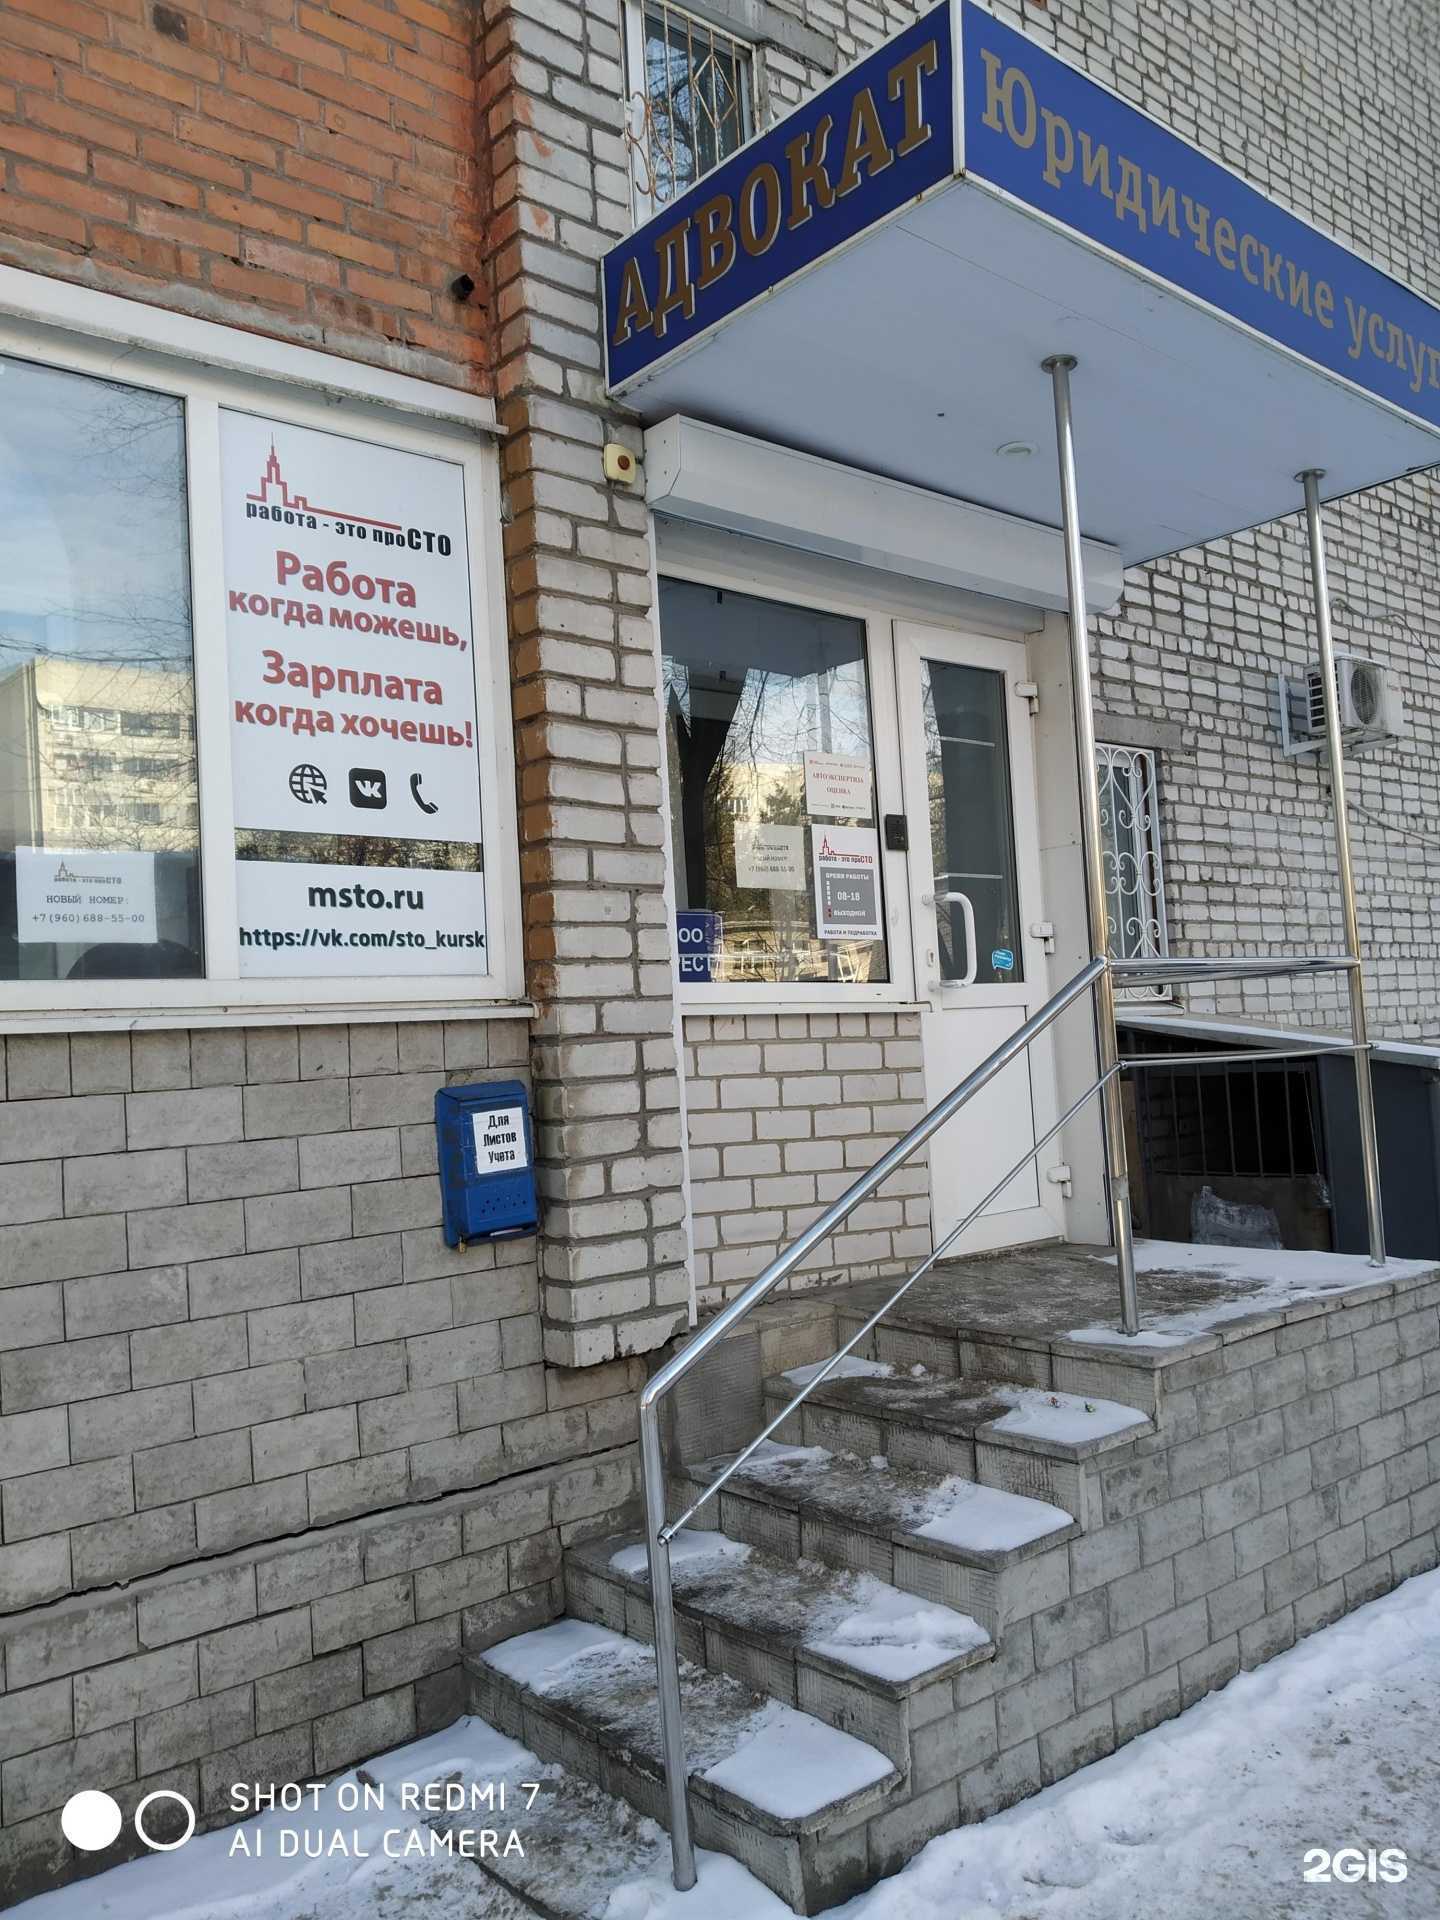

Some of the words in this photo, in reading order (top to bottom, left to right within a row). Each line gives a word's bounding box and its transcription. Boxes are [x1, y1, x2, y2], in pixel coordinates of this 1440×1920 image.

[613, 40, 938, 347] АДВОКАТ
[981, 48, 1334, 329] Юридические
[246, 502, 317, 529] работа
[335, 521, 367, 539] это
[373, 527, 452, 556] проСТО
[276, 550, 417, 608] Работа
[229, 590, 323, 628] когда
[329, 606, 468, 651] можешь,
[262, 649, 443, 706] Зарплата
[234, 700, 334, 737] когда
[341, 713, 474, 748] хочешь!
[46, 894, 82, 904] НОВЫЙ
[308, 884, 424, 910] msto.ru
[239, 927, 486, 951] https://vk.com/sto_kursk
[483, 1131, 517, 1147] Листов
[488, 1114, 509, 1130] Для
[488, 1150, 516, 1164] Учета
